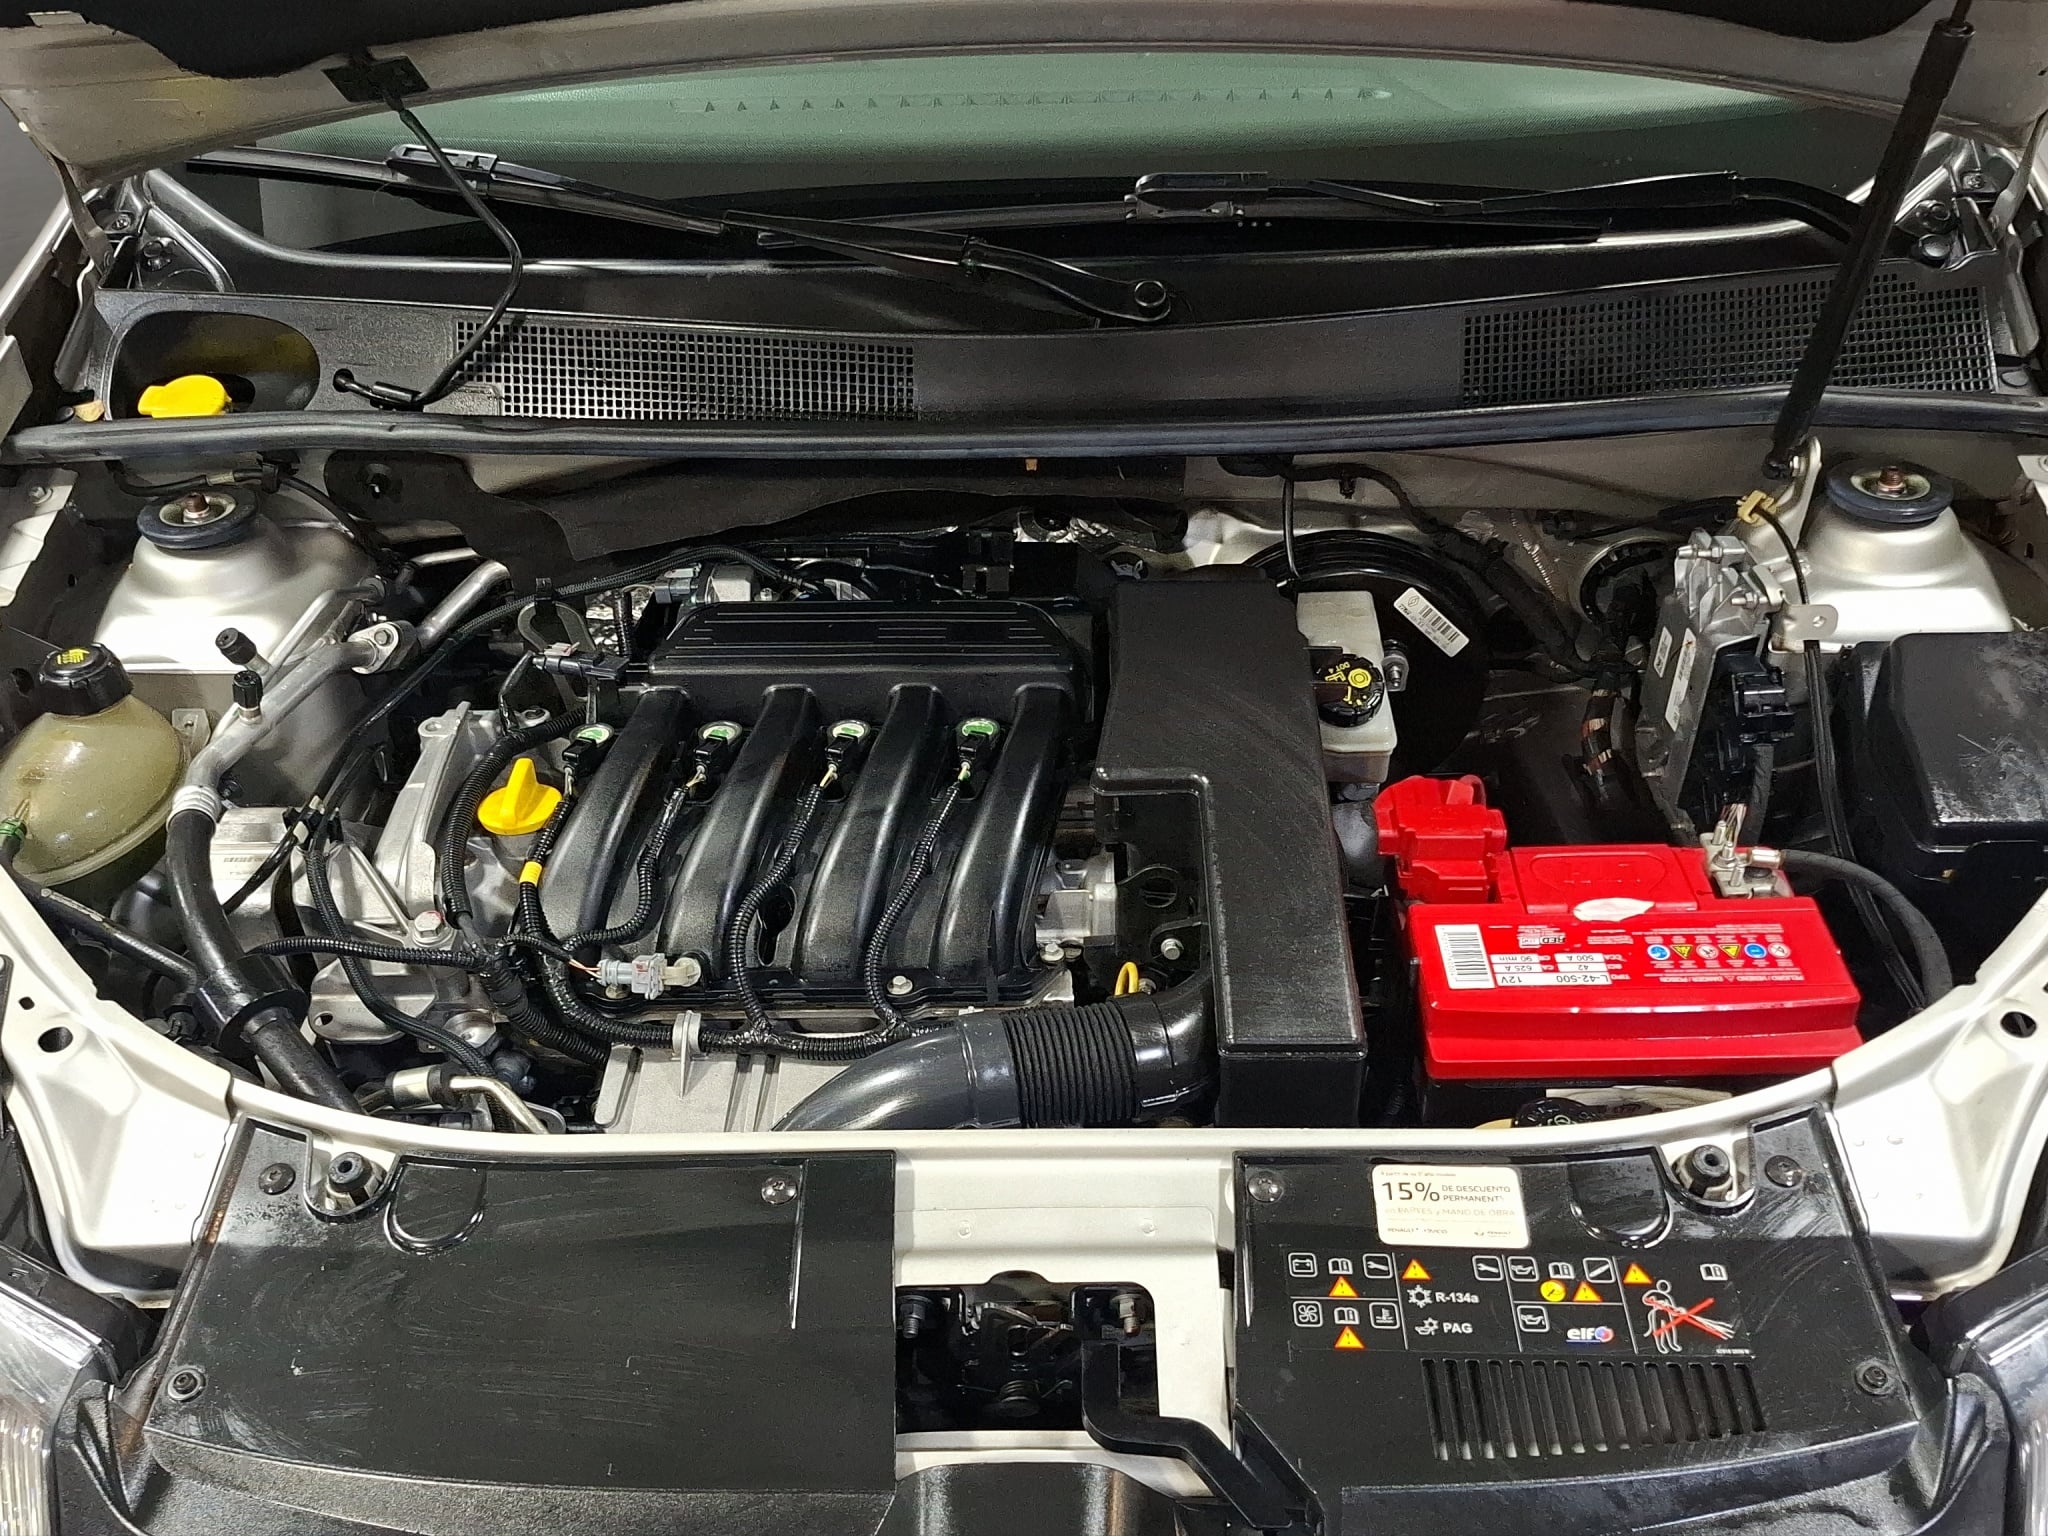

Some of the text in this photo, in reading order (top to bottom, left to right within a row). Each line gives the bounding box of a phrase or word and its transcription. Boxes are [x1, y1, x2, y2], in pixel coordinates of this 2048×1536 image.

[1501, 974, 1609, 984] L-42-500 12V
[1382, 1182, 1440, 1202] 15%
[1442, 1184, 1511, 1193] DE DESCUENTO
[1442, 1208, 1471, 1216] MANO
[1435, 1292, 1479, 1304] R-134a
[1443, 1323, 1473, 1334] PAG
[1566, 1327, 1595, 1340] elf
